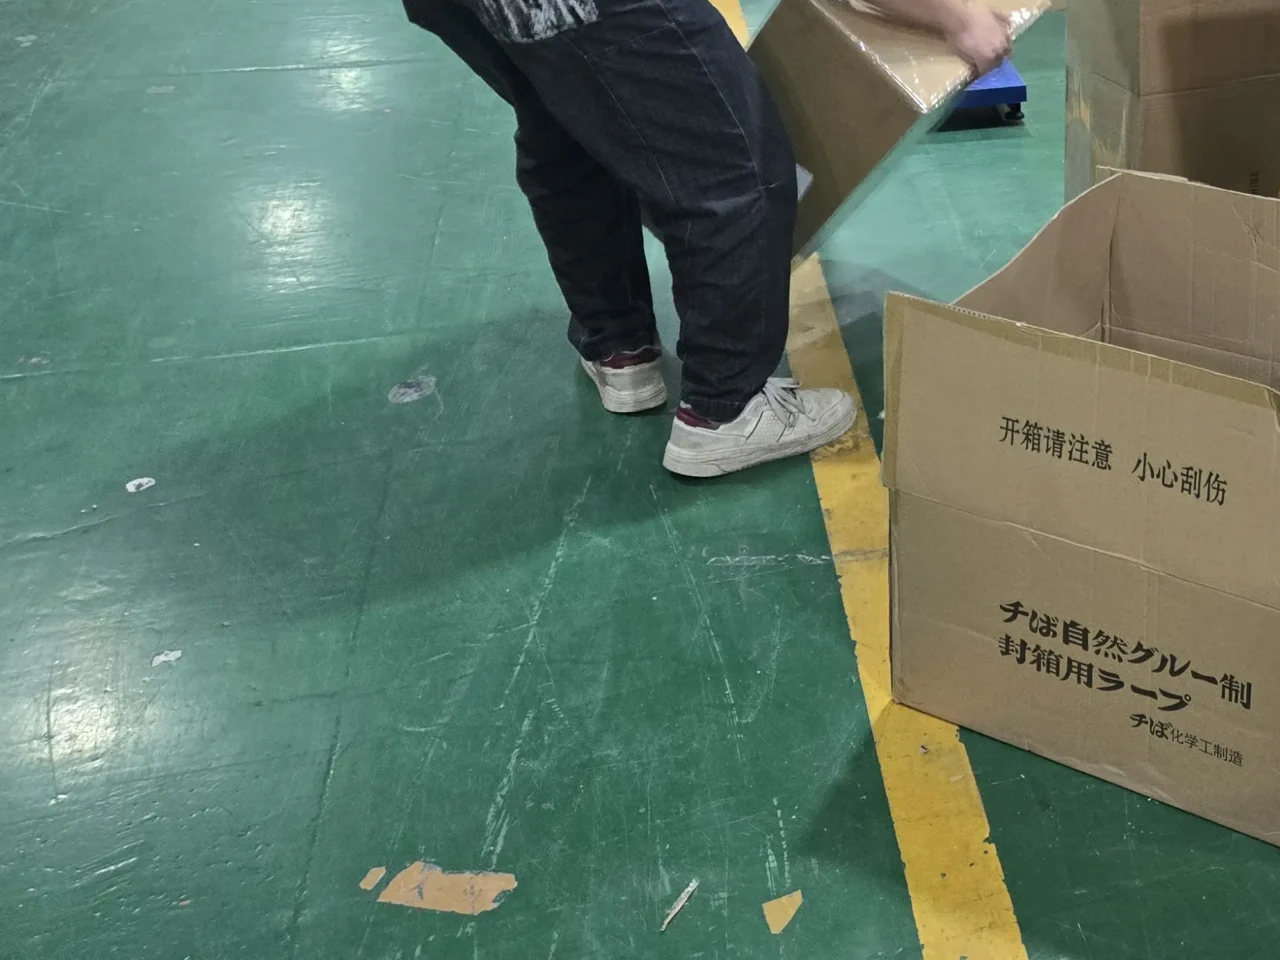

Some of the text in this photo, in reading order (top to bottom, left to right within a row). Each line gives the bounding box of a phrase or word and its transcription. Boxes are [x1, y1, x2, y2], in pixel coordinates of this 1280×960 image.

[998, 416, 1228, 506] 开箱请注意 小心刮伤
[999, 600, 1252, 710] チば自然グルー制
